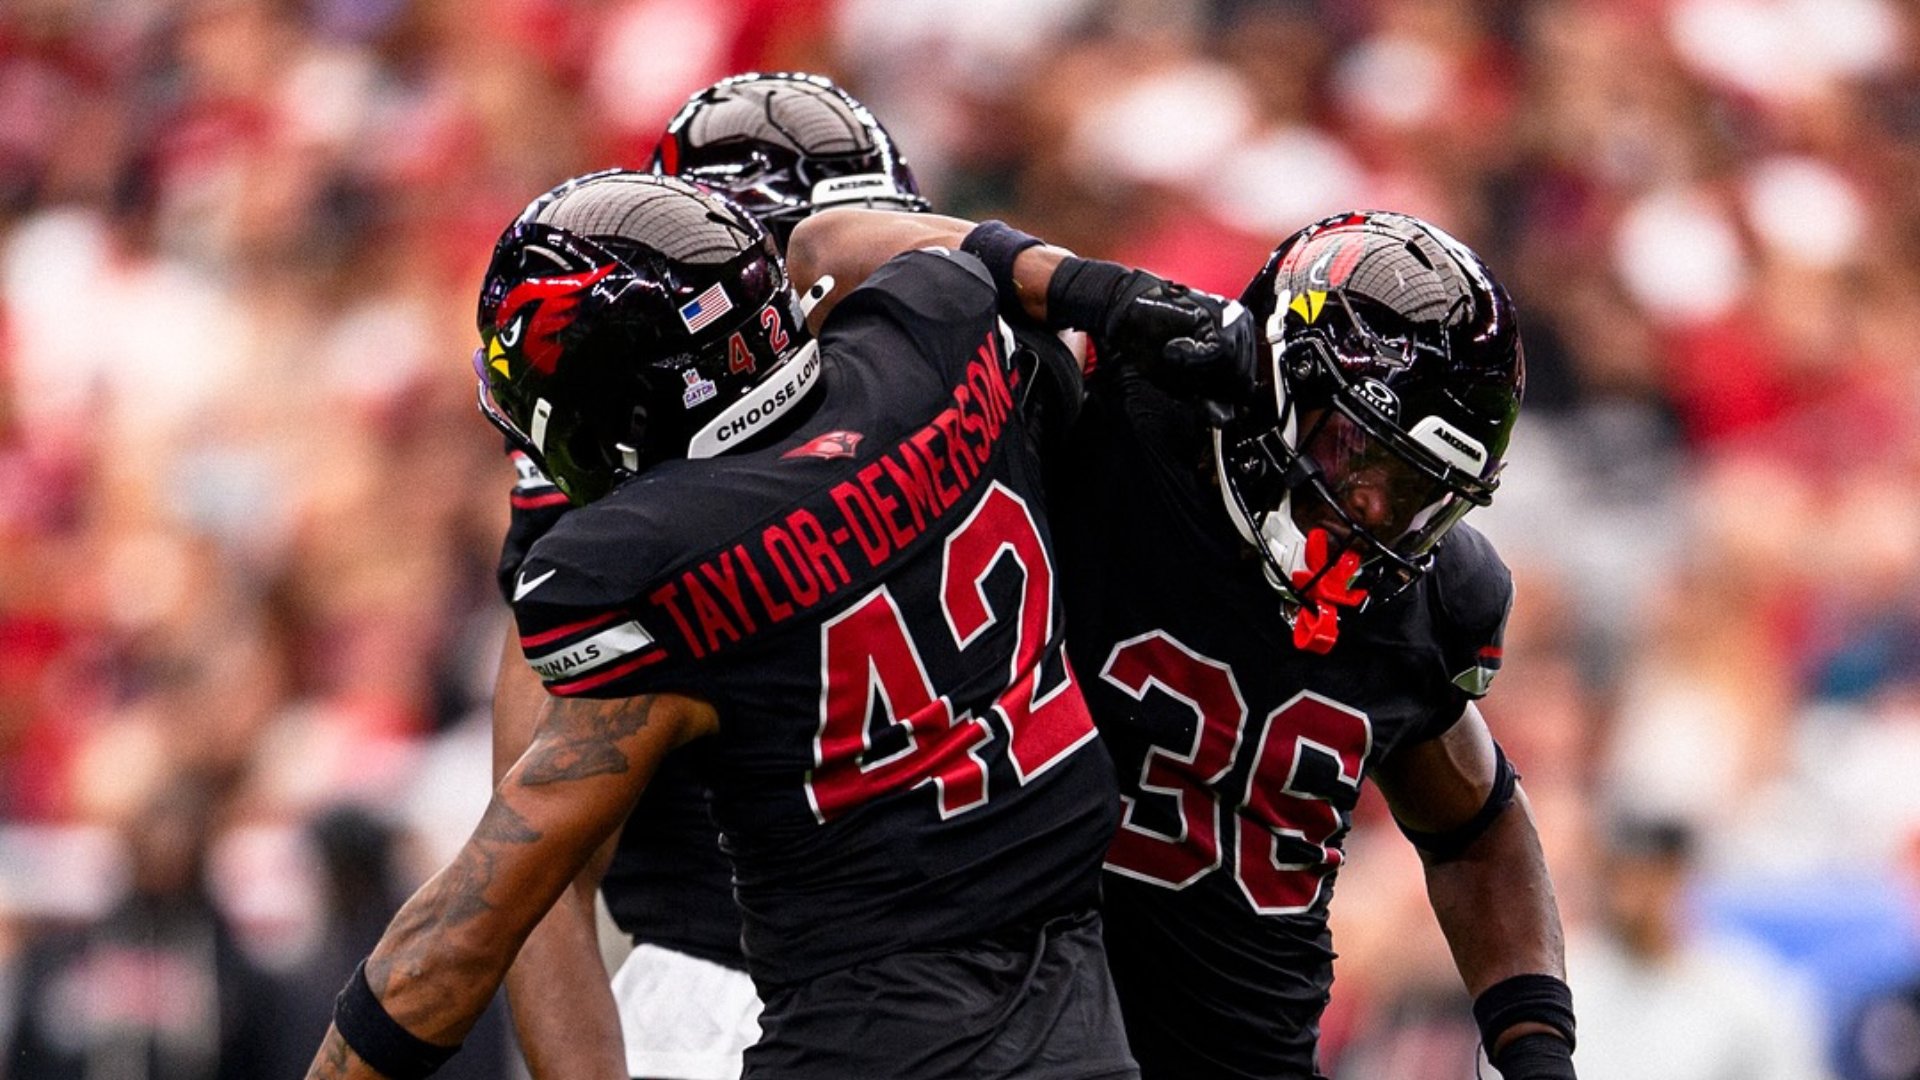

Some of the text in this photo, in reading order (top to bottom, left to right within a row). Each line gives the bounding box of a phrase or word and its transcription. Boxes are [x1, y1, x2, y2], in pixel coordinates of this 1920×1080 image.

[729, 305, 789, 374] 42
[716, 348, 819, 442] CHOOSE LOVE
[1353, 384, 1396, 416] OAKLEY
[1433, 427, 1482, 462] ARIZONA
[651, 331, 1013, 657] TAYLOR-DEMERSON
[531, 644, 601, 677] DINALS
[803, 479, 1098, 825] 42
[1099, 628, 1372, 915] 36
